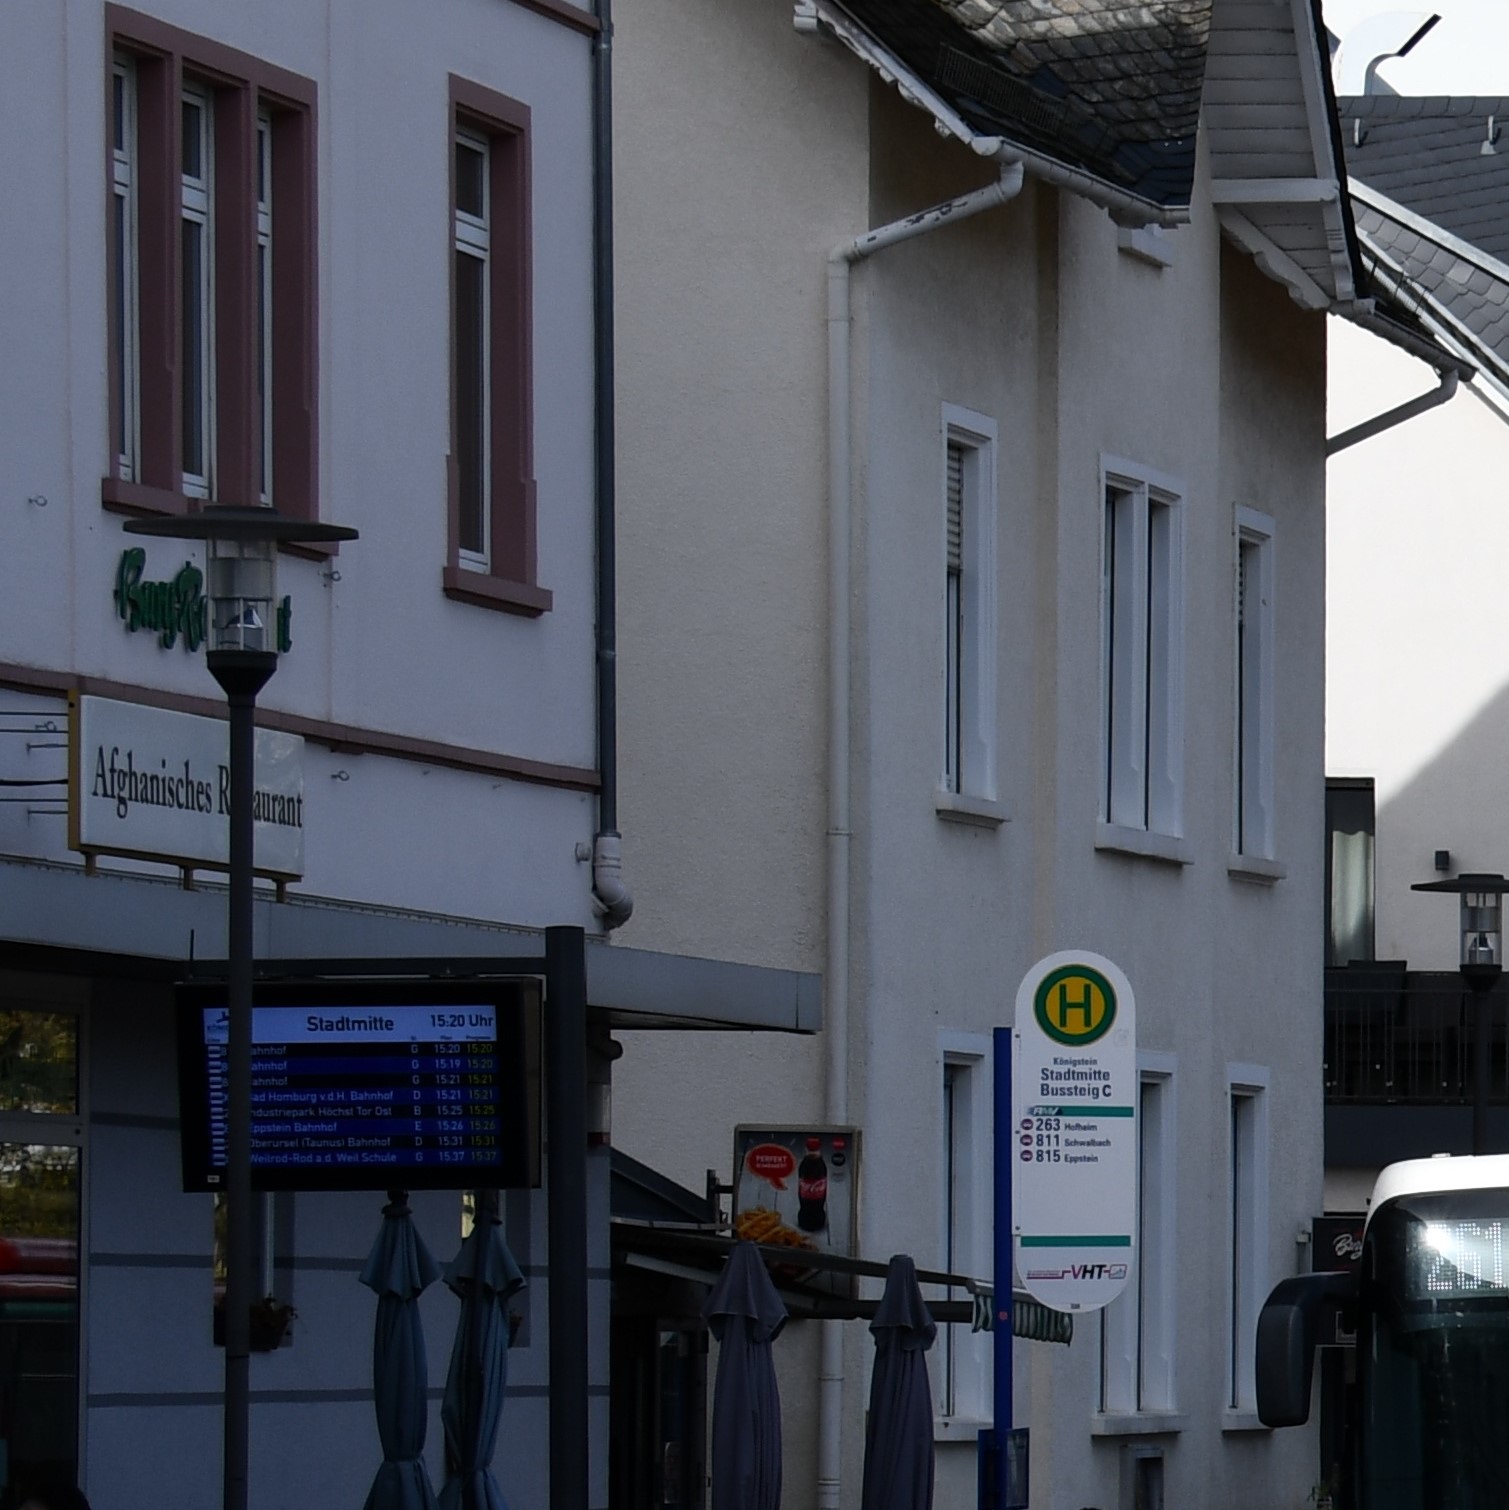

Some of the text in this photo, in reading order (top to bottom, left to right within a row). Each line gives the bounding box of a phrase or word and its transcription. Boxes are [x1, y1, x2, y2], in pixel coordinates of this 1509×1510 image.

[92, 745, 303, 829] Afghanisches Raurant
[1059, 983, 1092, 1028] H
[307, 1014, 495, 1032] Stadtmitte 15:20 Uhr
[250, 1044, 494, 1056] ahnhof G 15:20 15:20
[250, 1060, 288, 1071] ahnhof
[434, 1059, 462, 1069] 15:19
[1053, 1057, 1098, 1067] Königstein
[250, 1074, 493, 1087] ahnhof G 15:21 15:21
[1040, 1067, 1111, 1081] Stadtmitte
[268, 1091, 317, 1104] Homburg
[350, 1090, 394, 1101] Bahnhof
[413, 1090, 422, 1100] D
[436, 1090, 462, 1100] 15:21
[469, 1089, 493, 1100] 15:21
[1040, 1083, 1112, 1100] Bussteig C
[250, 1104, 496, 1119] ndustriepark Höchst Tor Ost B 15:25 15:25
[294, 1121, 338, 1133] Bahnhof
[414, 1121, 423, 1131] E
[437, 1120, 464, 1131] 15:26
[1035, 1118, 1098, 1131] 263 Hofheim
[301, 1137, 345, 1149] (Taunus)
[347, 1136, 391, 1147] Bahnhof
[415, 1136, 423, 1147] D
[438, 1136, 464, 1146] 15:31
[471, 1135, 495, 1146] 15:31
[1035, 1133, 1060, 1147] 811
[336, 1152, 359, 1163] Weil
[361, 1152, 397, 1163] Schule
[415, 1152, 424, 1162] G
[439, 1151, 465, 1162] 15:37
[1035, 1149, 1099, 1164] 815 Eppstein
[1071, 1264, 1107, 1279] VHT
